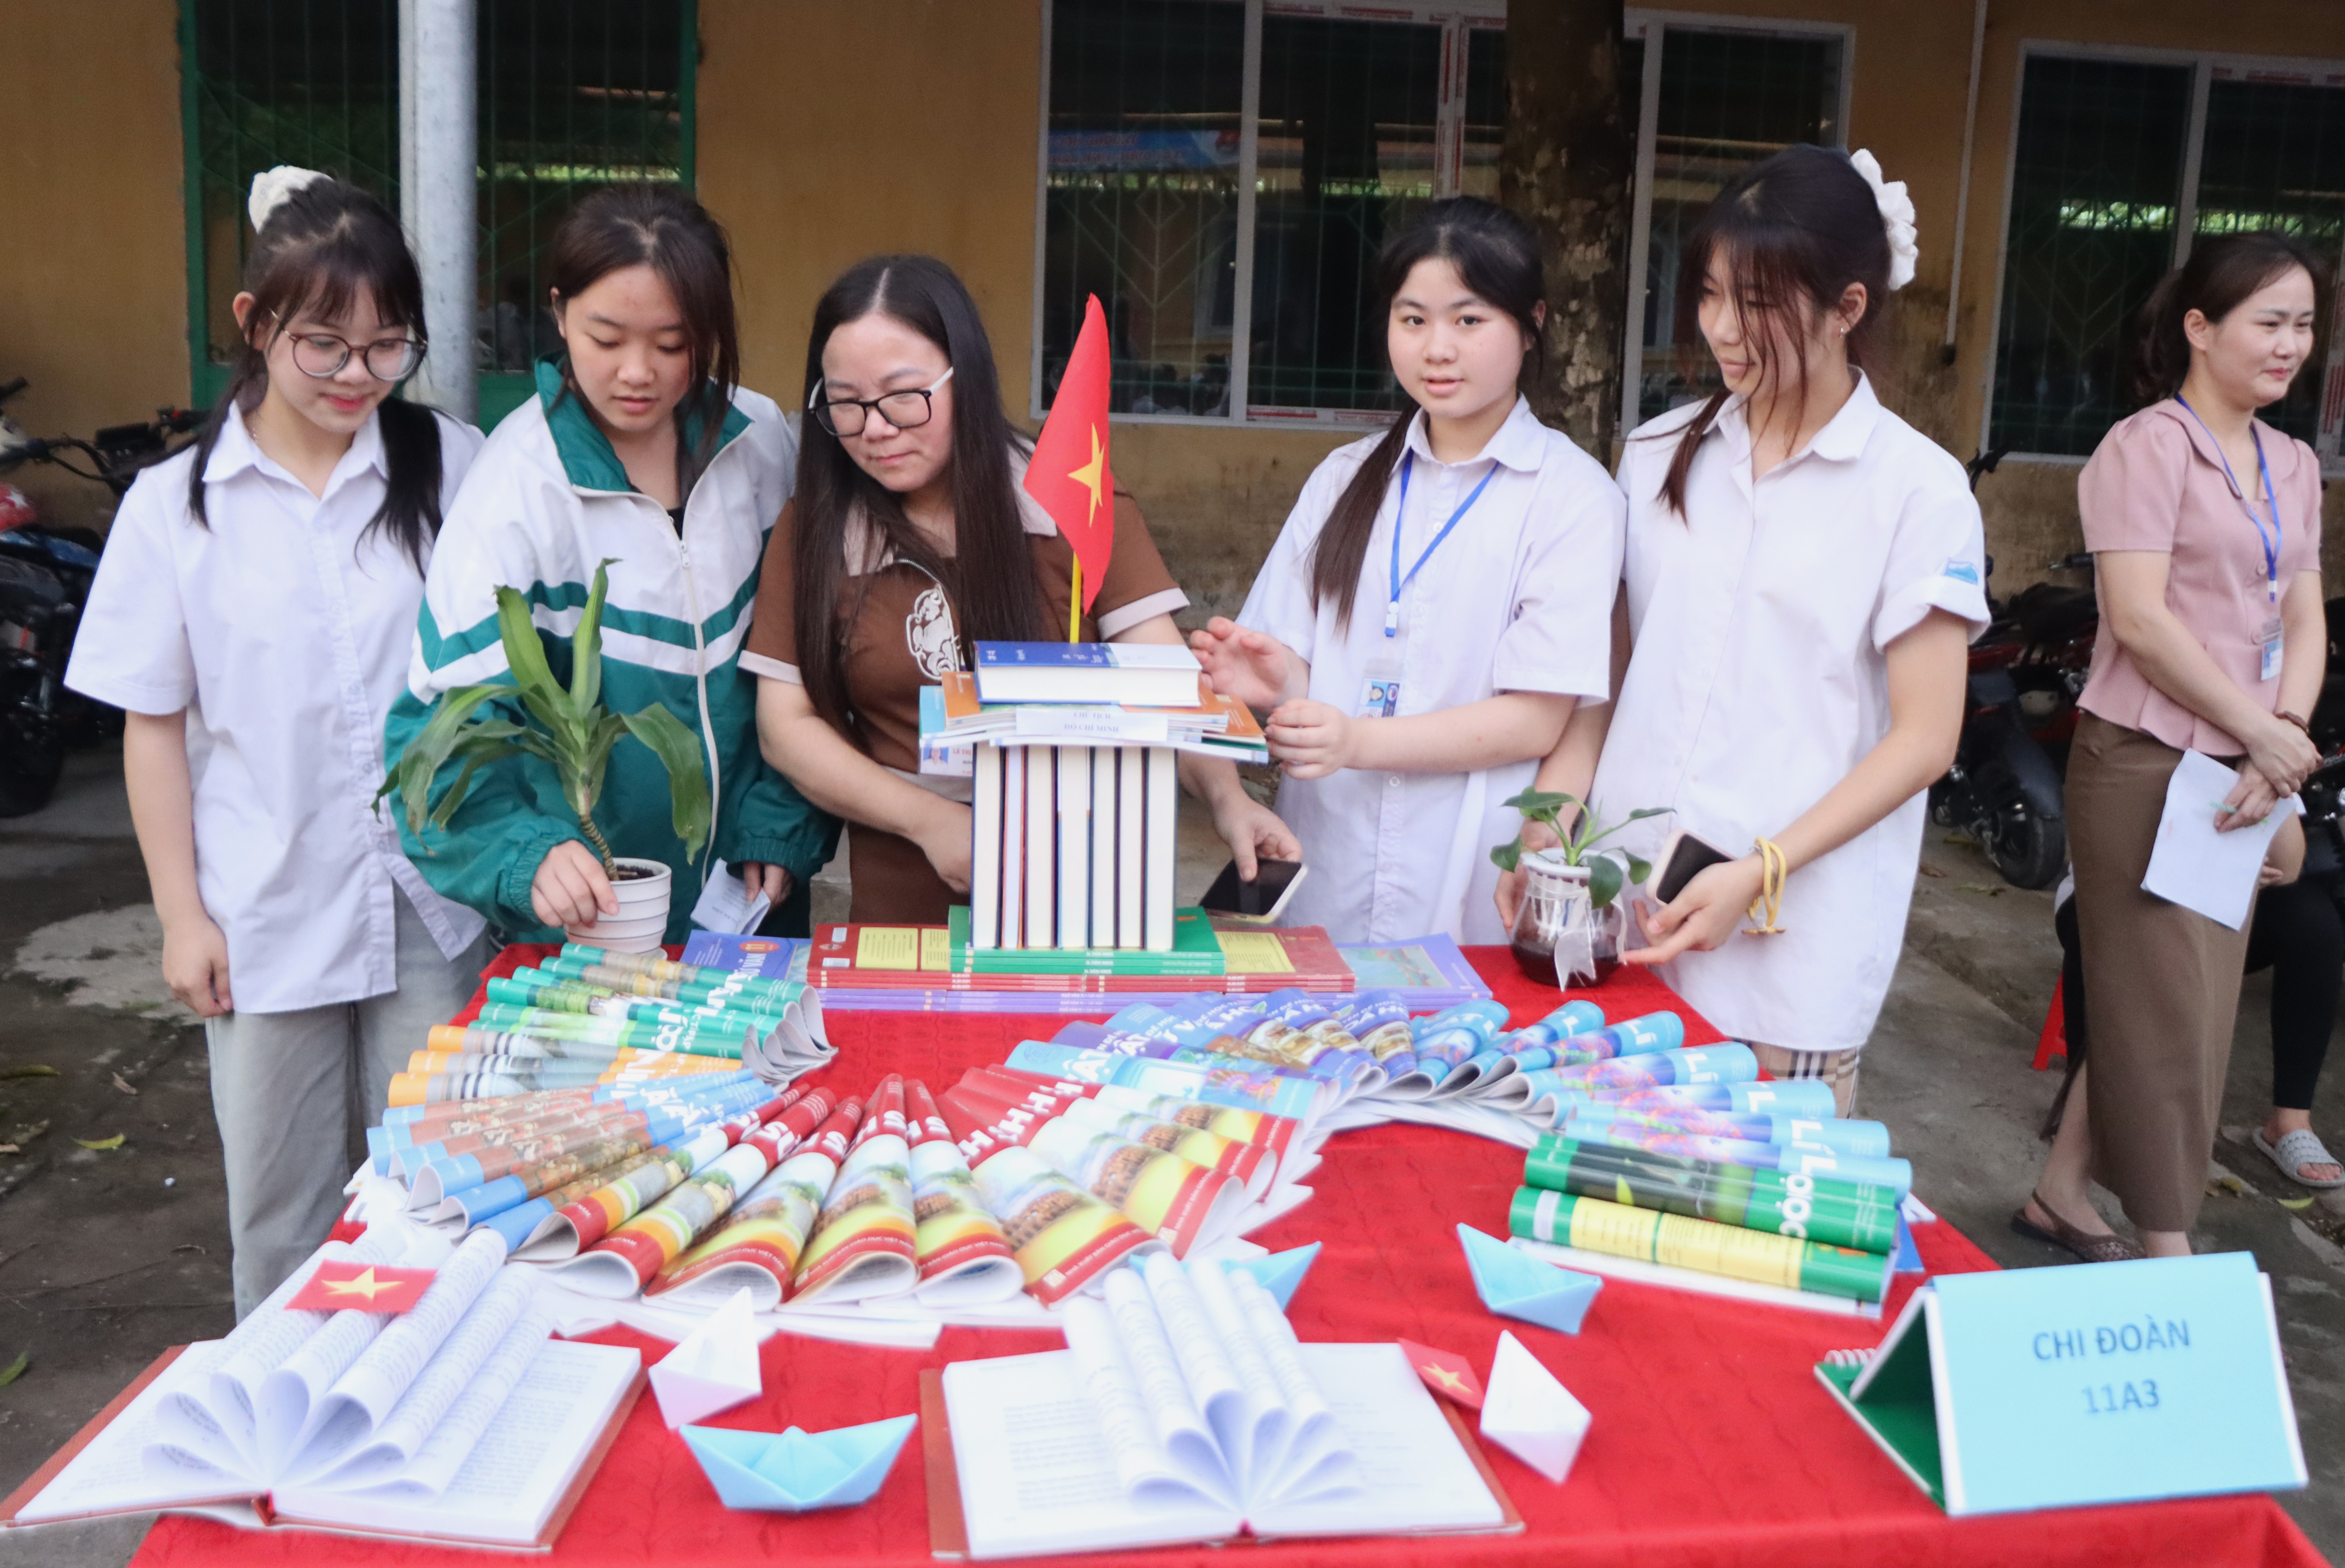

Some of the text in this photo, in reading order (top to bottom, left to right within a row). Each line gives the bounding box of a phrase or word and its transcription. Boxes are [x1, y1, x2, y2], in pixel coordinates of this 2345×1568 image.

[2032, 1314, 2190, 1361] CHI ĐOÀN
[2082, 1380, 2160, 1414] 11A3
